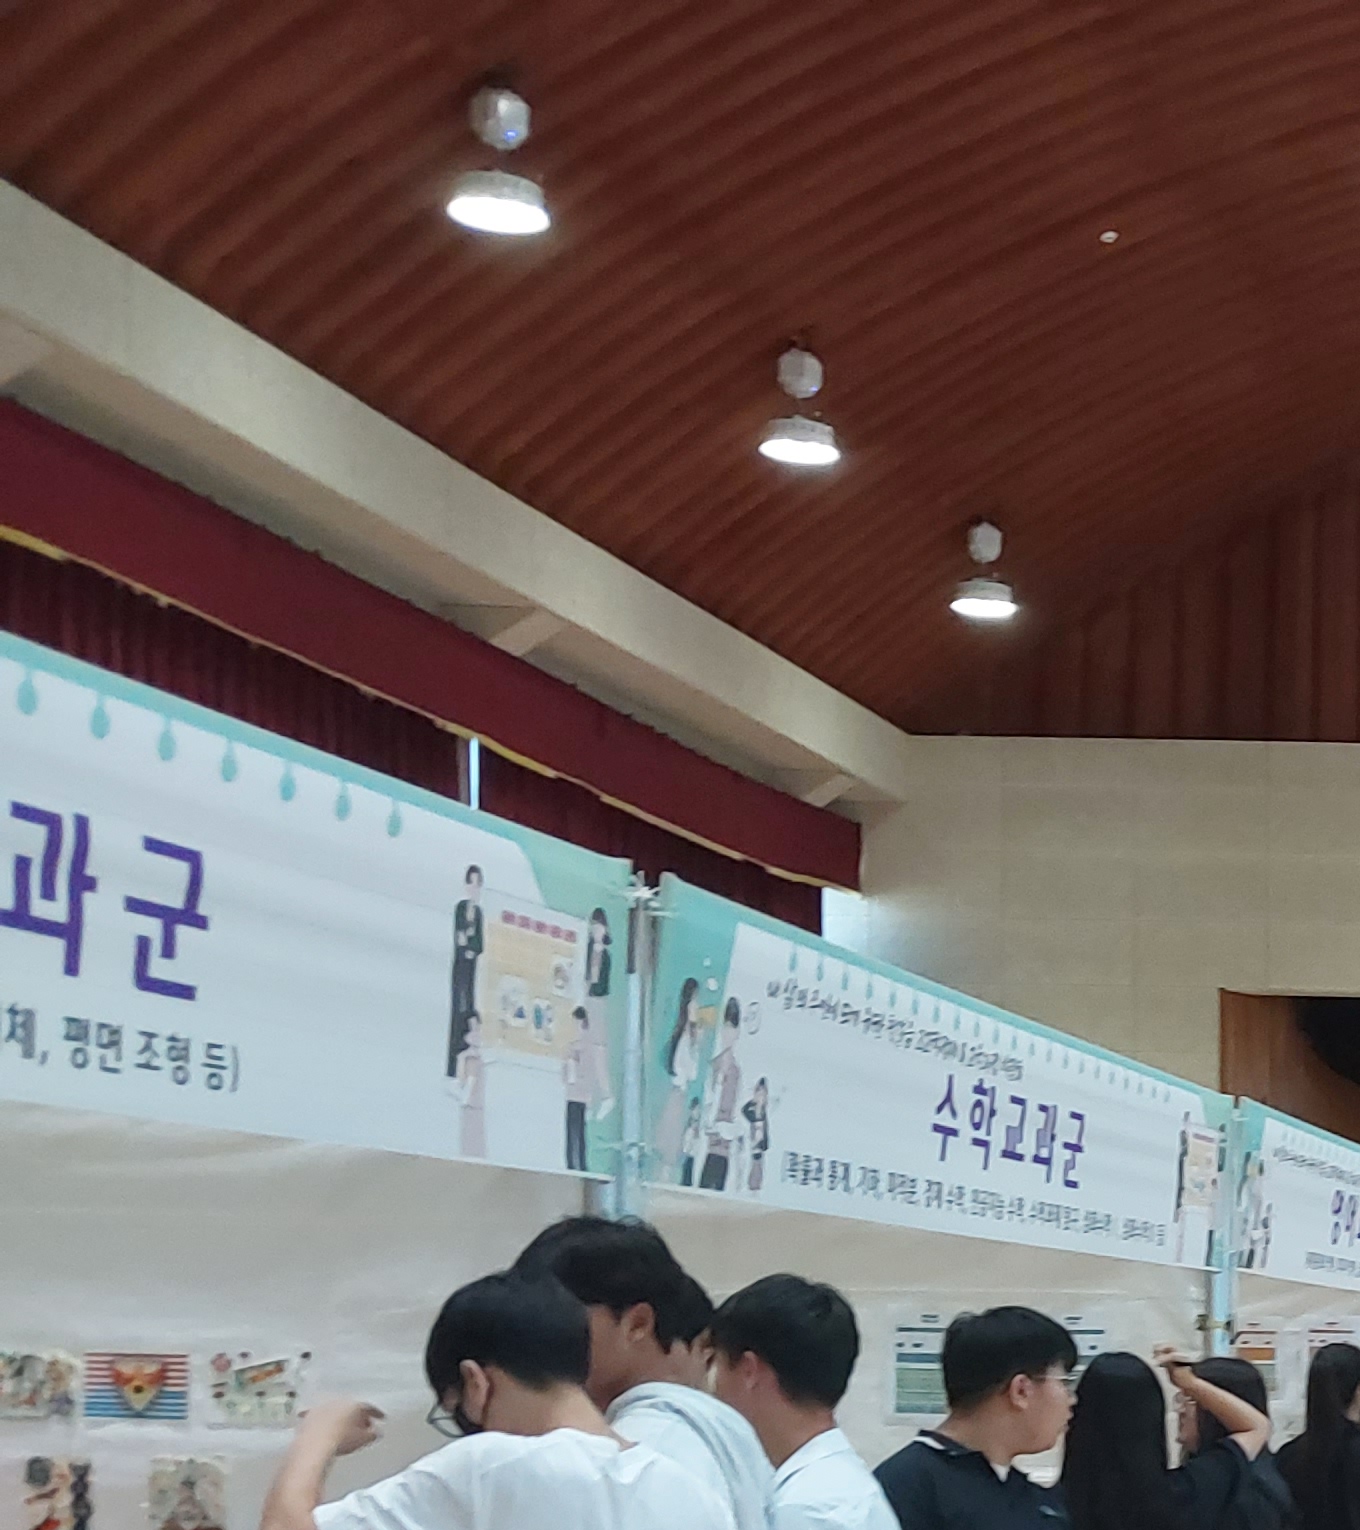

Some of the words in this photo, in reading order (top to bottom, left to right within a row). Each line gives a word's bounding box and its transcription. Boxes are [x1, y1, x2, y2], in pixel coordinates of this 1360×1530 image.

[63, 1016, 122, 1075] 평면
[135, 1029, 191, 1086] 조형
[202, 1041, 238, 1092] 등)
[931, 1074, 1086, 1189] 수학교과군
